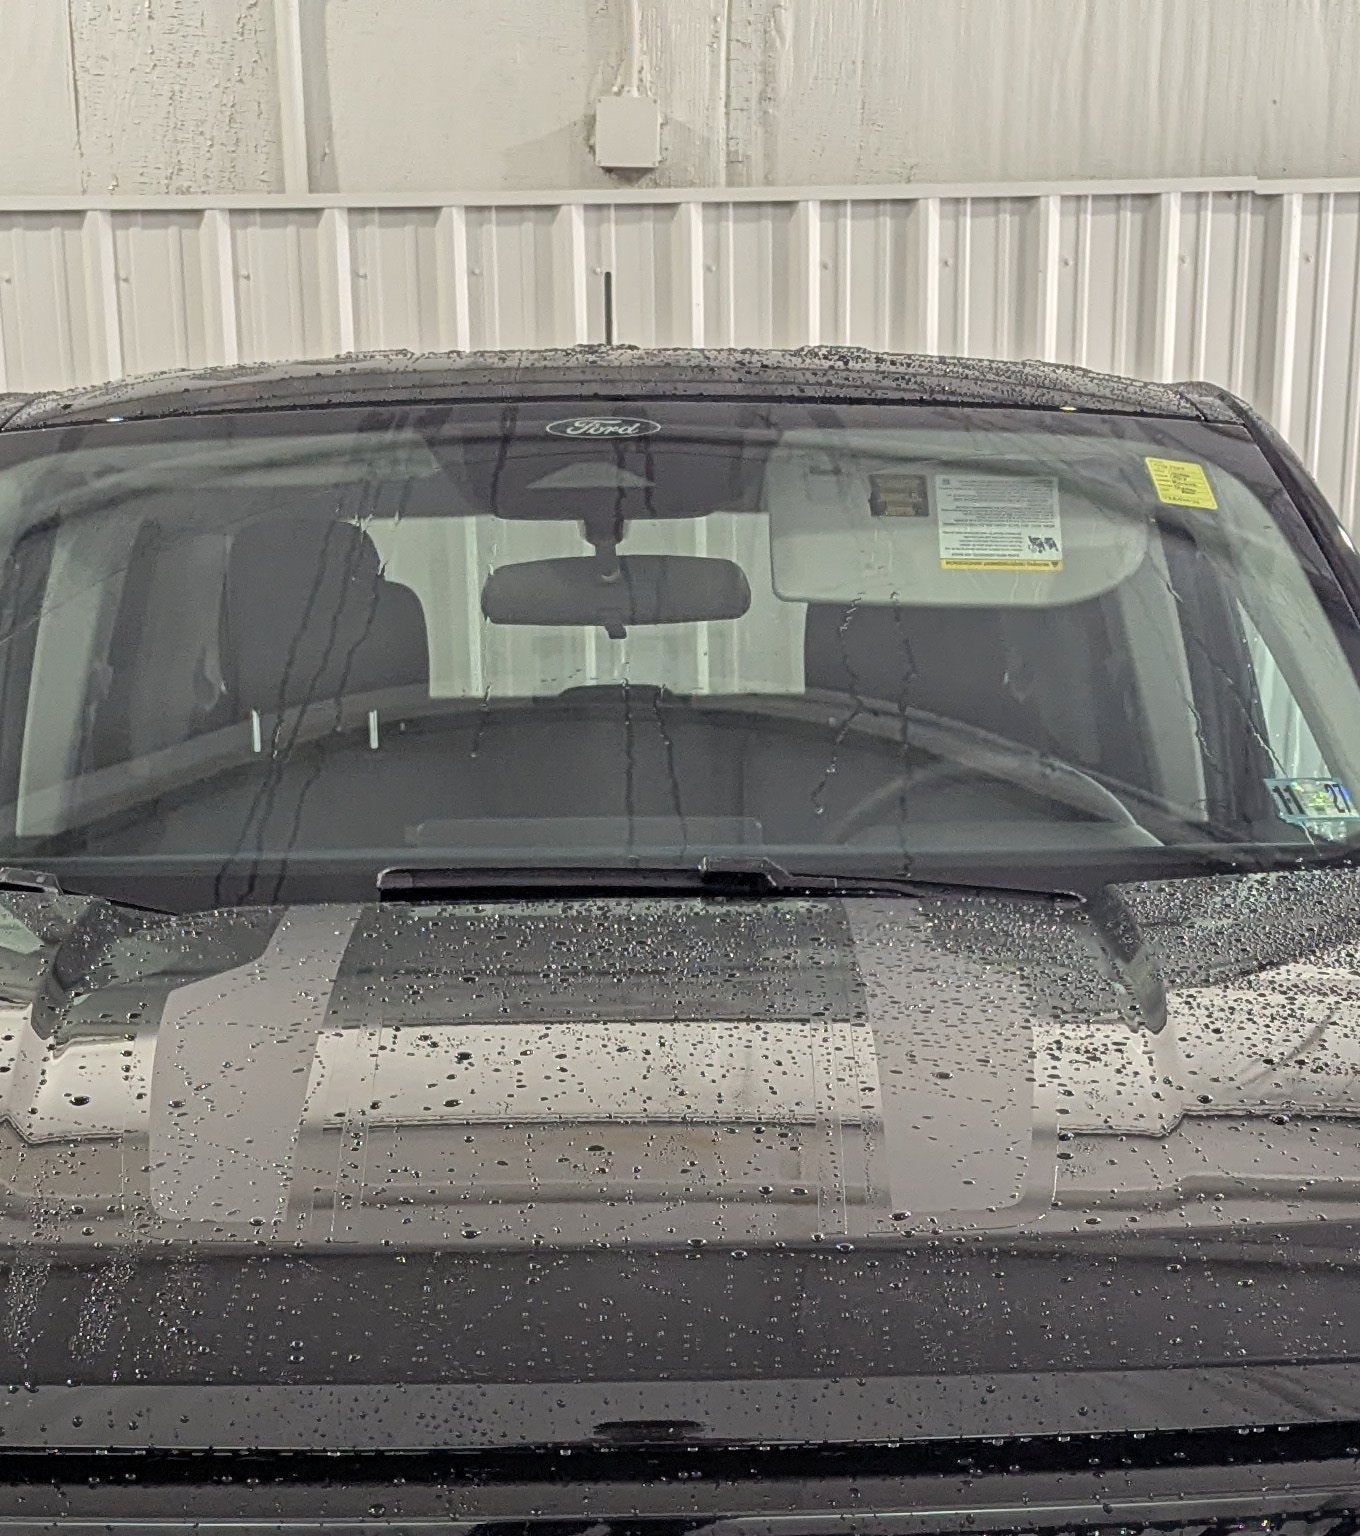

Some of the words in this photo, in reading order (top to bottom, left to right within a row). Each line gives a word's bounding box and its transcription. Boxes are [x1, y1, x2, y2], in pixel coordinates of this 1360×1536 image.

[566, 419, 641, 435] Ford
[1272, 785, 1305, 815] 11
[1324, 783, 1352, 814] 27
